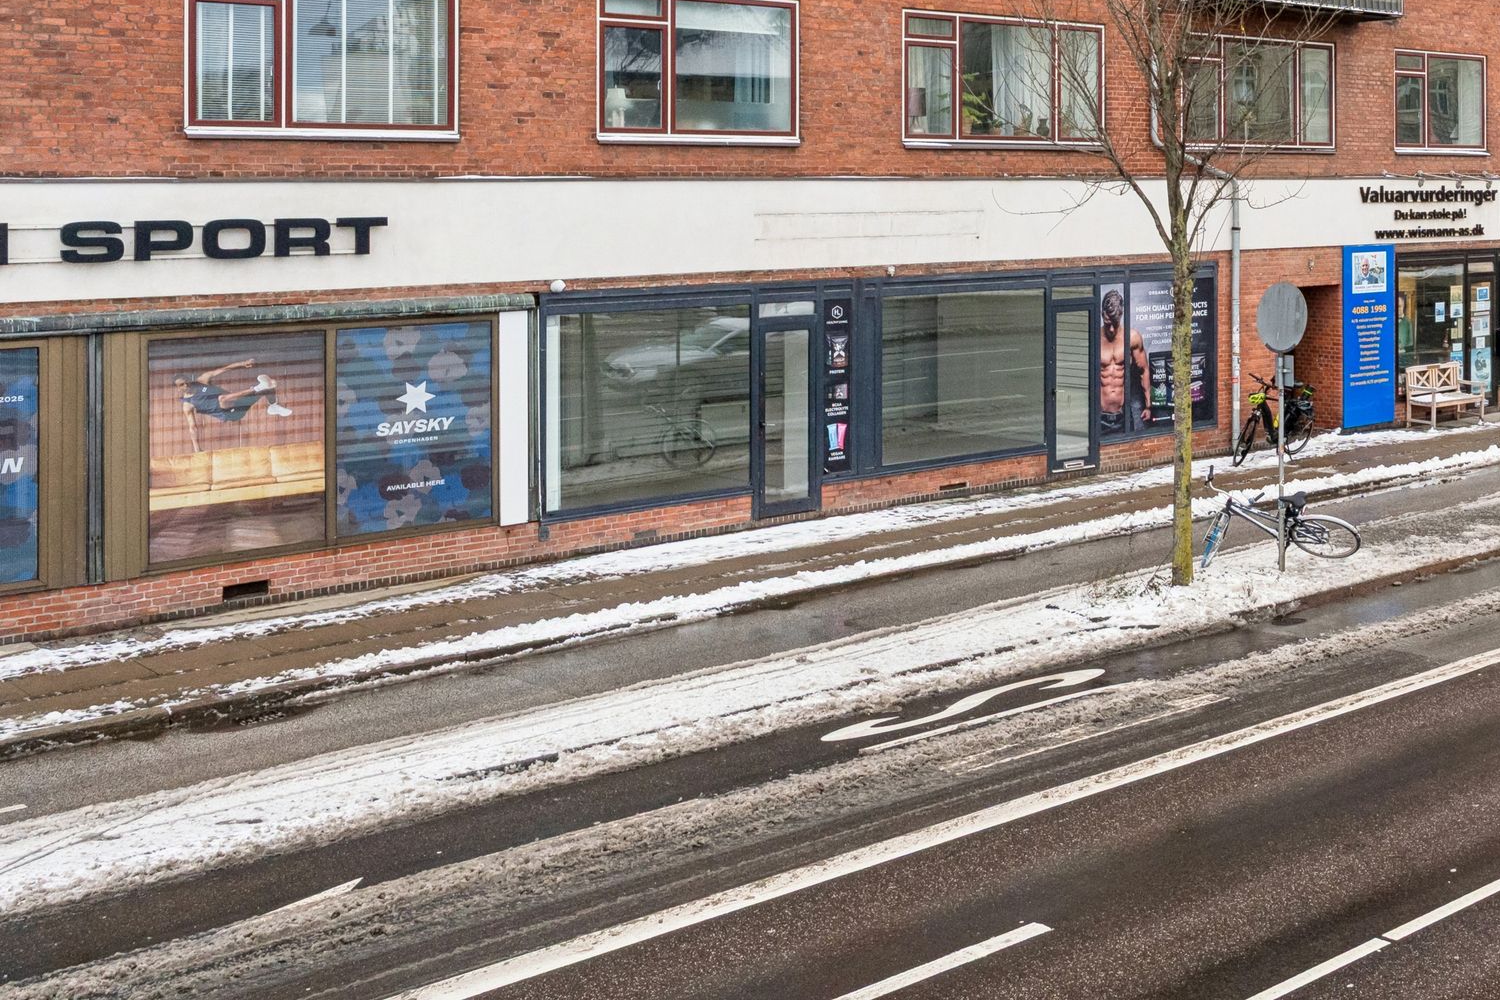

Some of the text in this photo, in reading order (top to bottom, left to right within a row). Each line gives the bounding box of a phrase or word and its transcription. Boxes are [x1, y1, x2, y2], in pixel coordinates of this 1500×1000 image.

[1359, 185, 1498, 206] Valuarvurderinger
[1394, 208, 1467, 221] Du kan stole på!
[1375, 224, 1485, 239] www.wismann-as.dk
[60, 216, 388, 263] SPORT
[1135, 305, 1151, 313] HIGH
[1149, 312, 1164, 320] HIGH
[376, 416, 455, 437] SAYSKY
[393, 436, 439, 445] COPENHAGEN
[386, 479, 446, 492] AVAILABLE HERE
